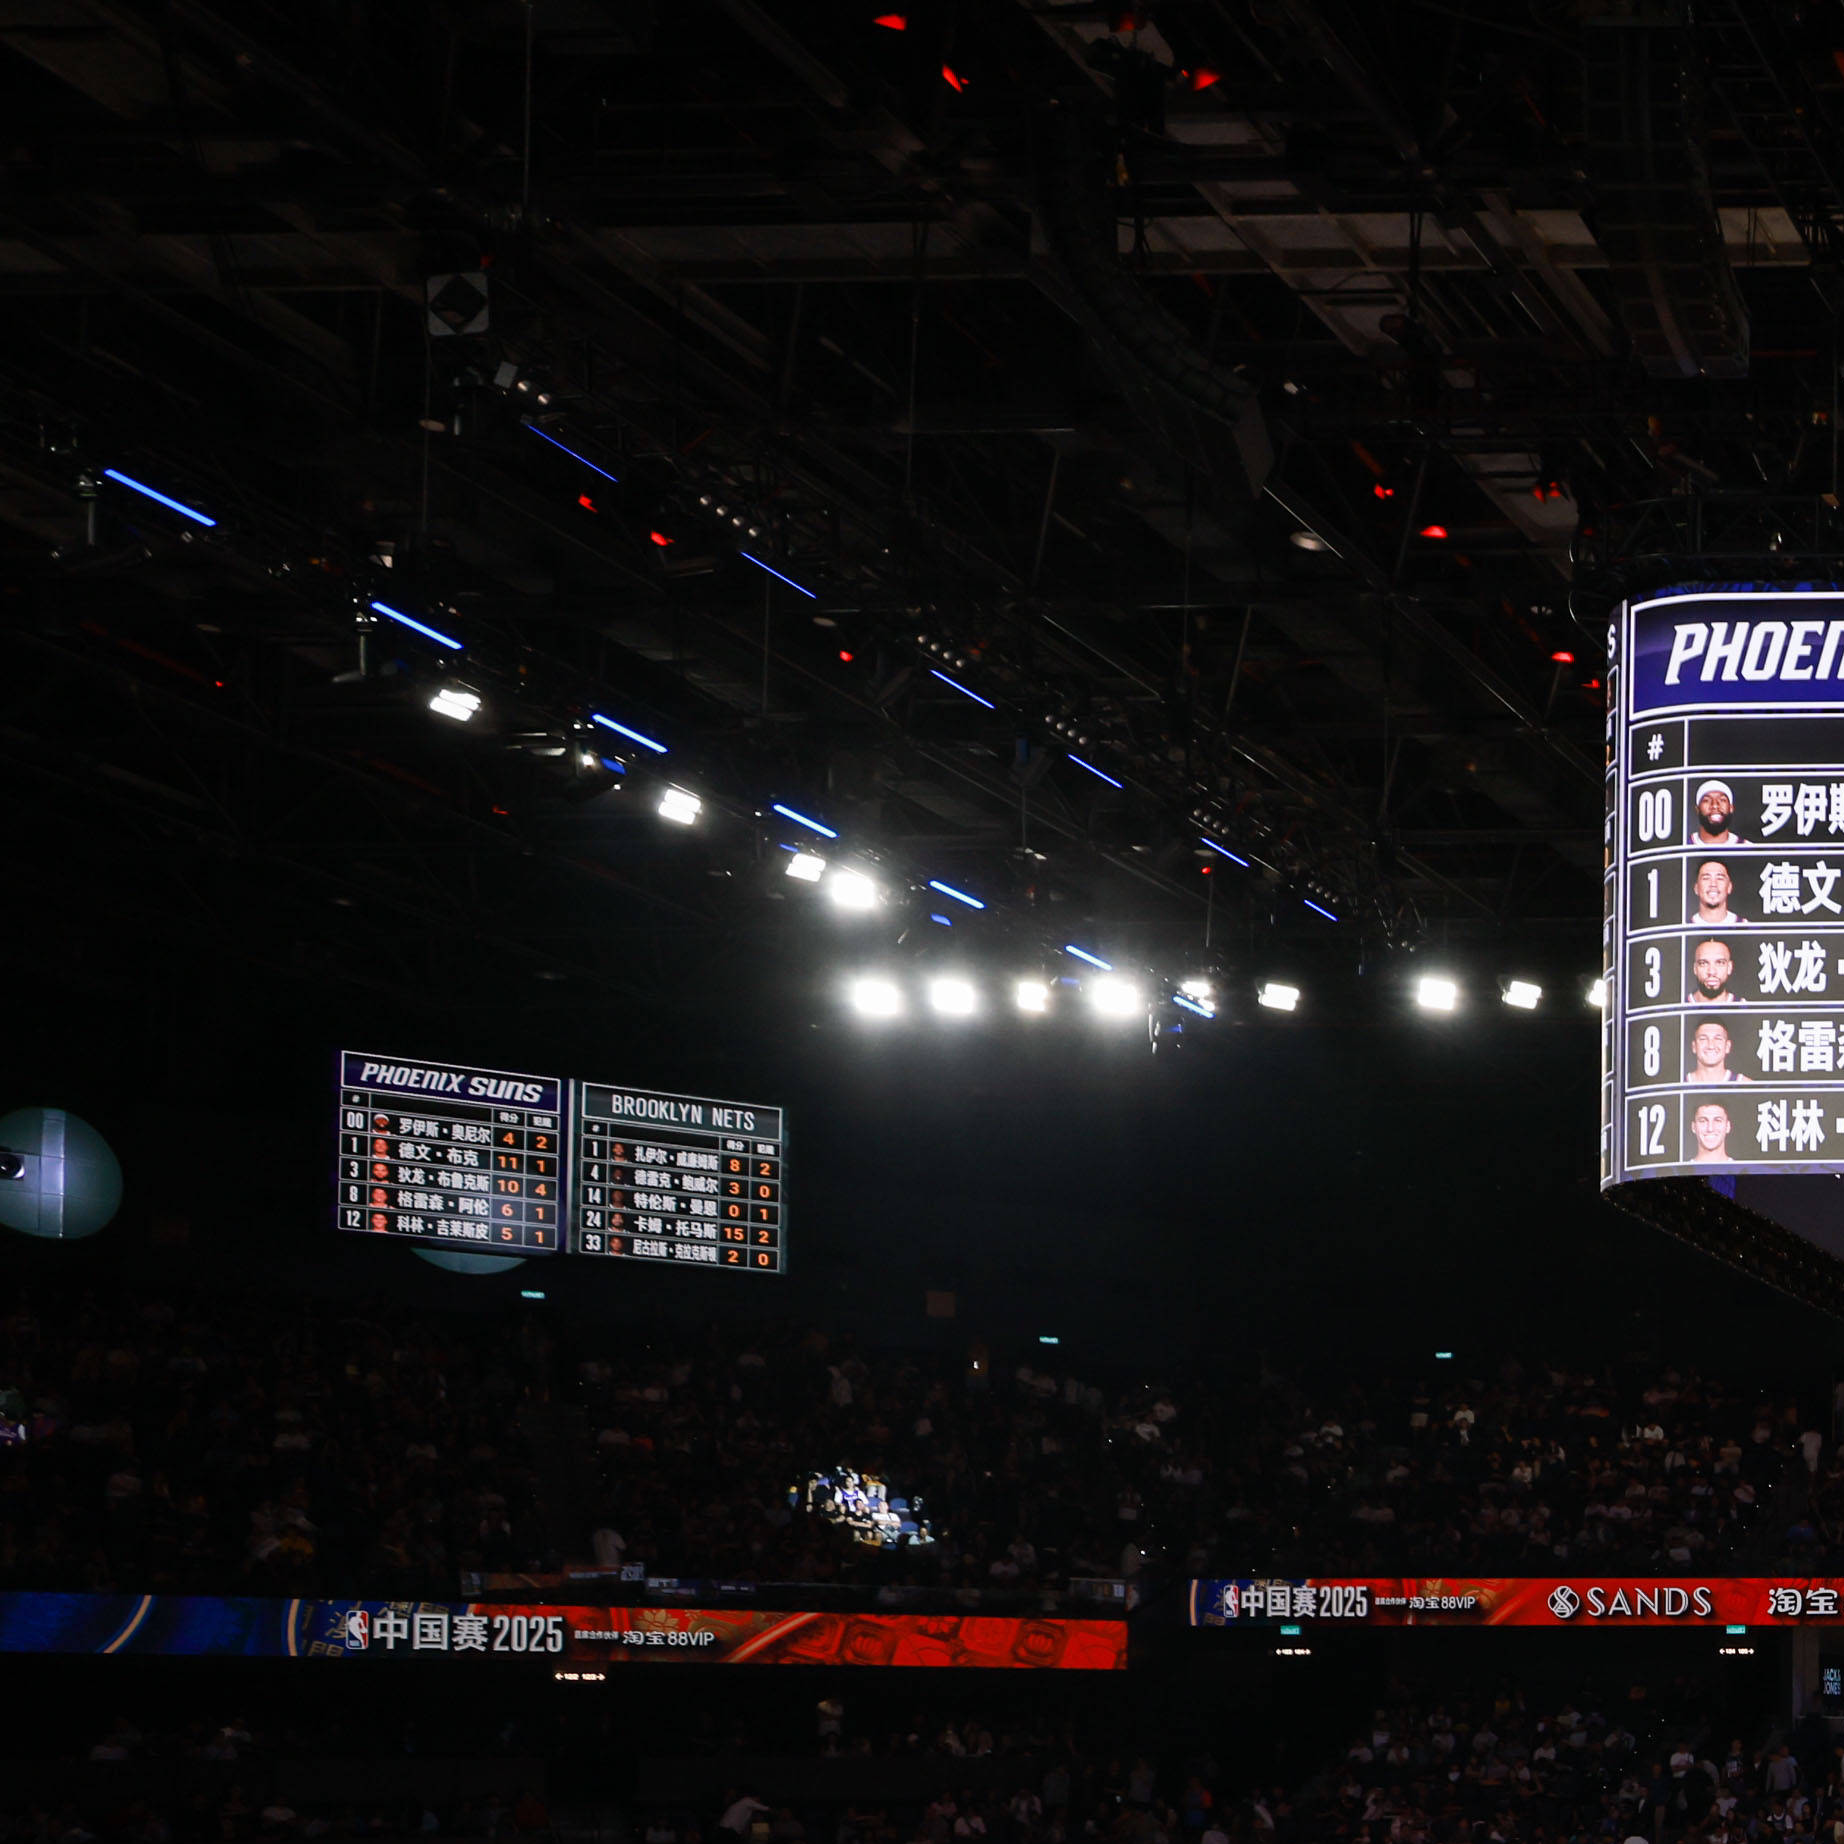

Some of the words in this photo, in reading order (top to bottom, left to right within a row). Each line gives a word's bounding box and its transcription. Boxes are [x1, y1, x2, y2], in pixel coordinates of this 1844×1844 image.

[1648, 734, 1664, 760] #
[1639, 792, 1671, 841] 00
[1648, 869, 1658, 918] 1
[1645, 947, 1660, 997] 3
[1644, 1026, 1660, 1076] 8
[360, 1062, 465, 1093] PHOENIX
[468, 1076, 543, 1103] SUNS
[612, 1094, 702, 1124] BROOKLYN
[712, 1109, 755, 1130] NETS
[1639, 1105, 1665, 1155] 12
[1587, 1587, 1712, 1616] SANDS
